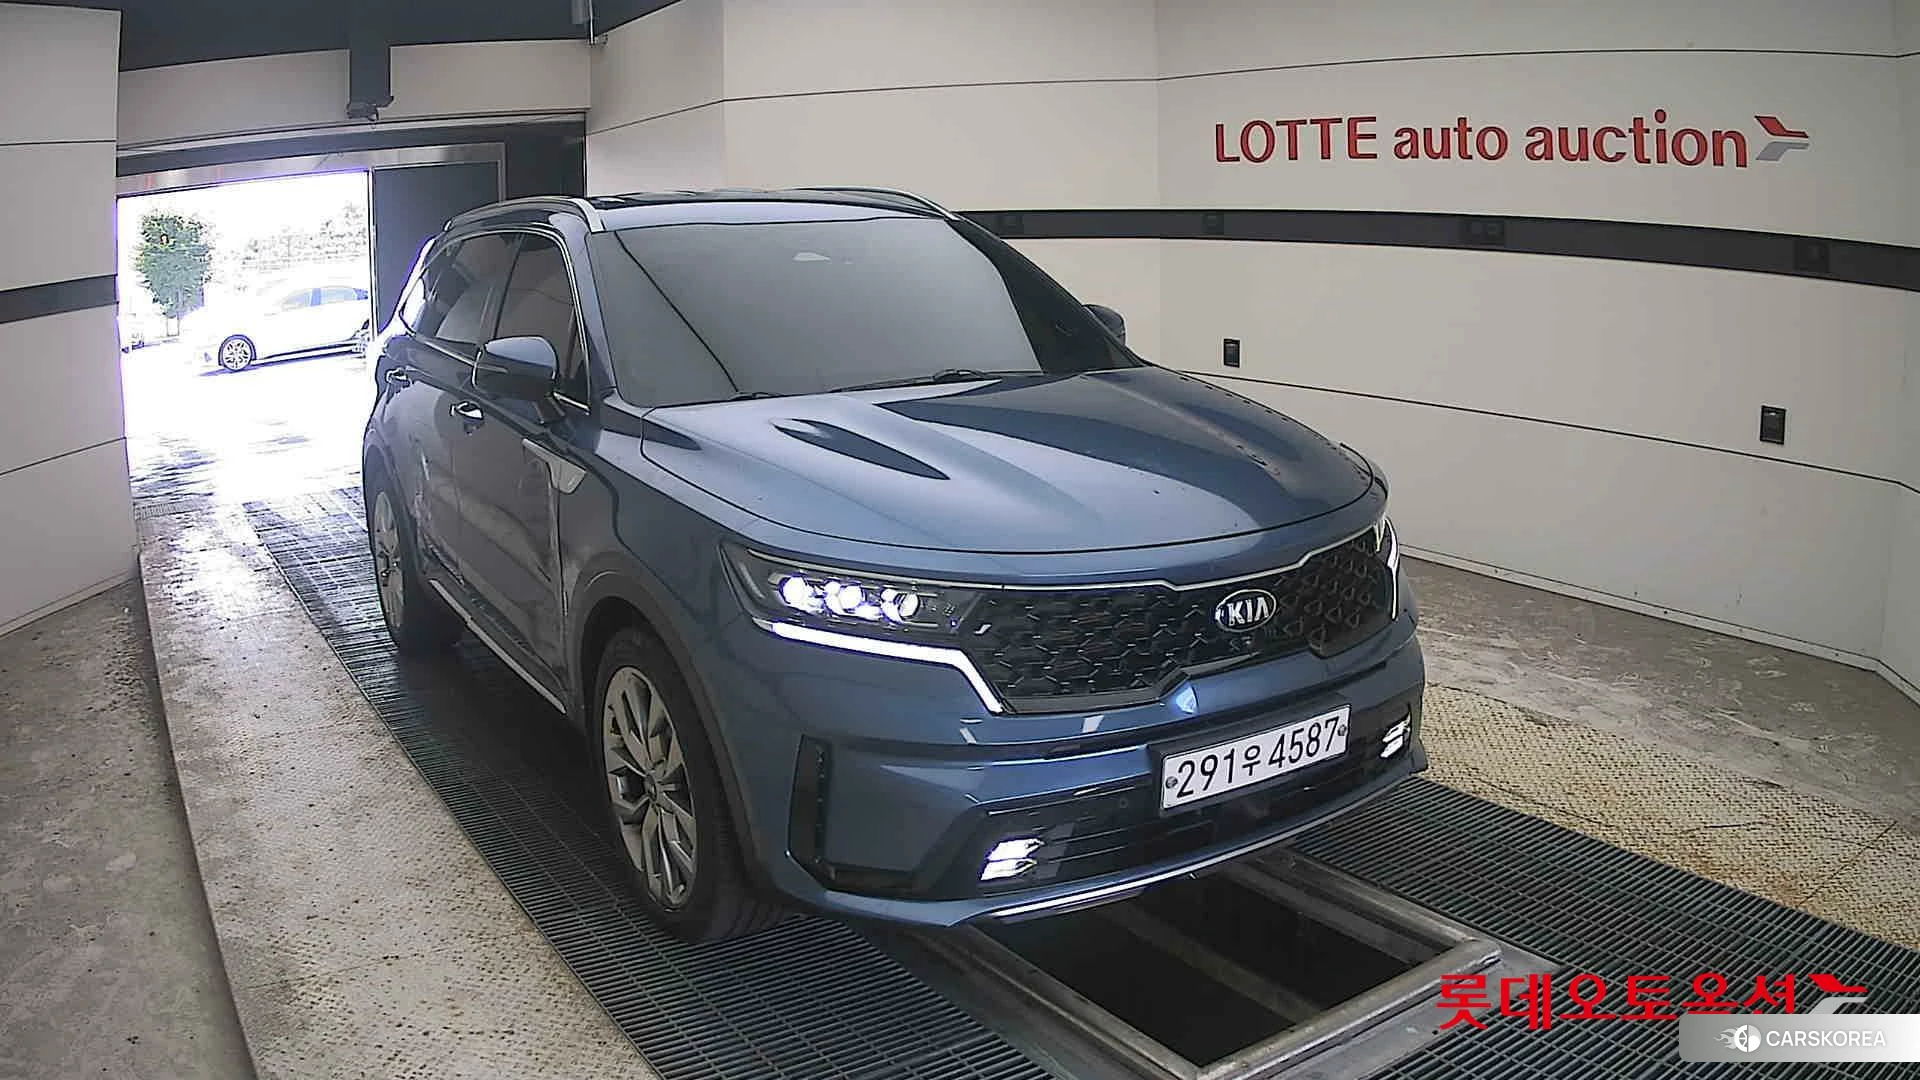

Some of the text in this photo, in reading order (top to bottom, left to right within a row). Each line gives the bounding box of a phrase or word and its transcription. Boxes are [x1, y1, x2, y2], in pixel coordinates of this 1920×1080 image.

[1215, 109, 1747, 167] LOTTE auto auction
[1226, 597, 1269, 626] KIA
[1176, 716, 1340, 798] 291우 4587
